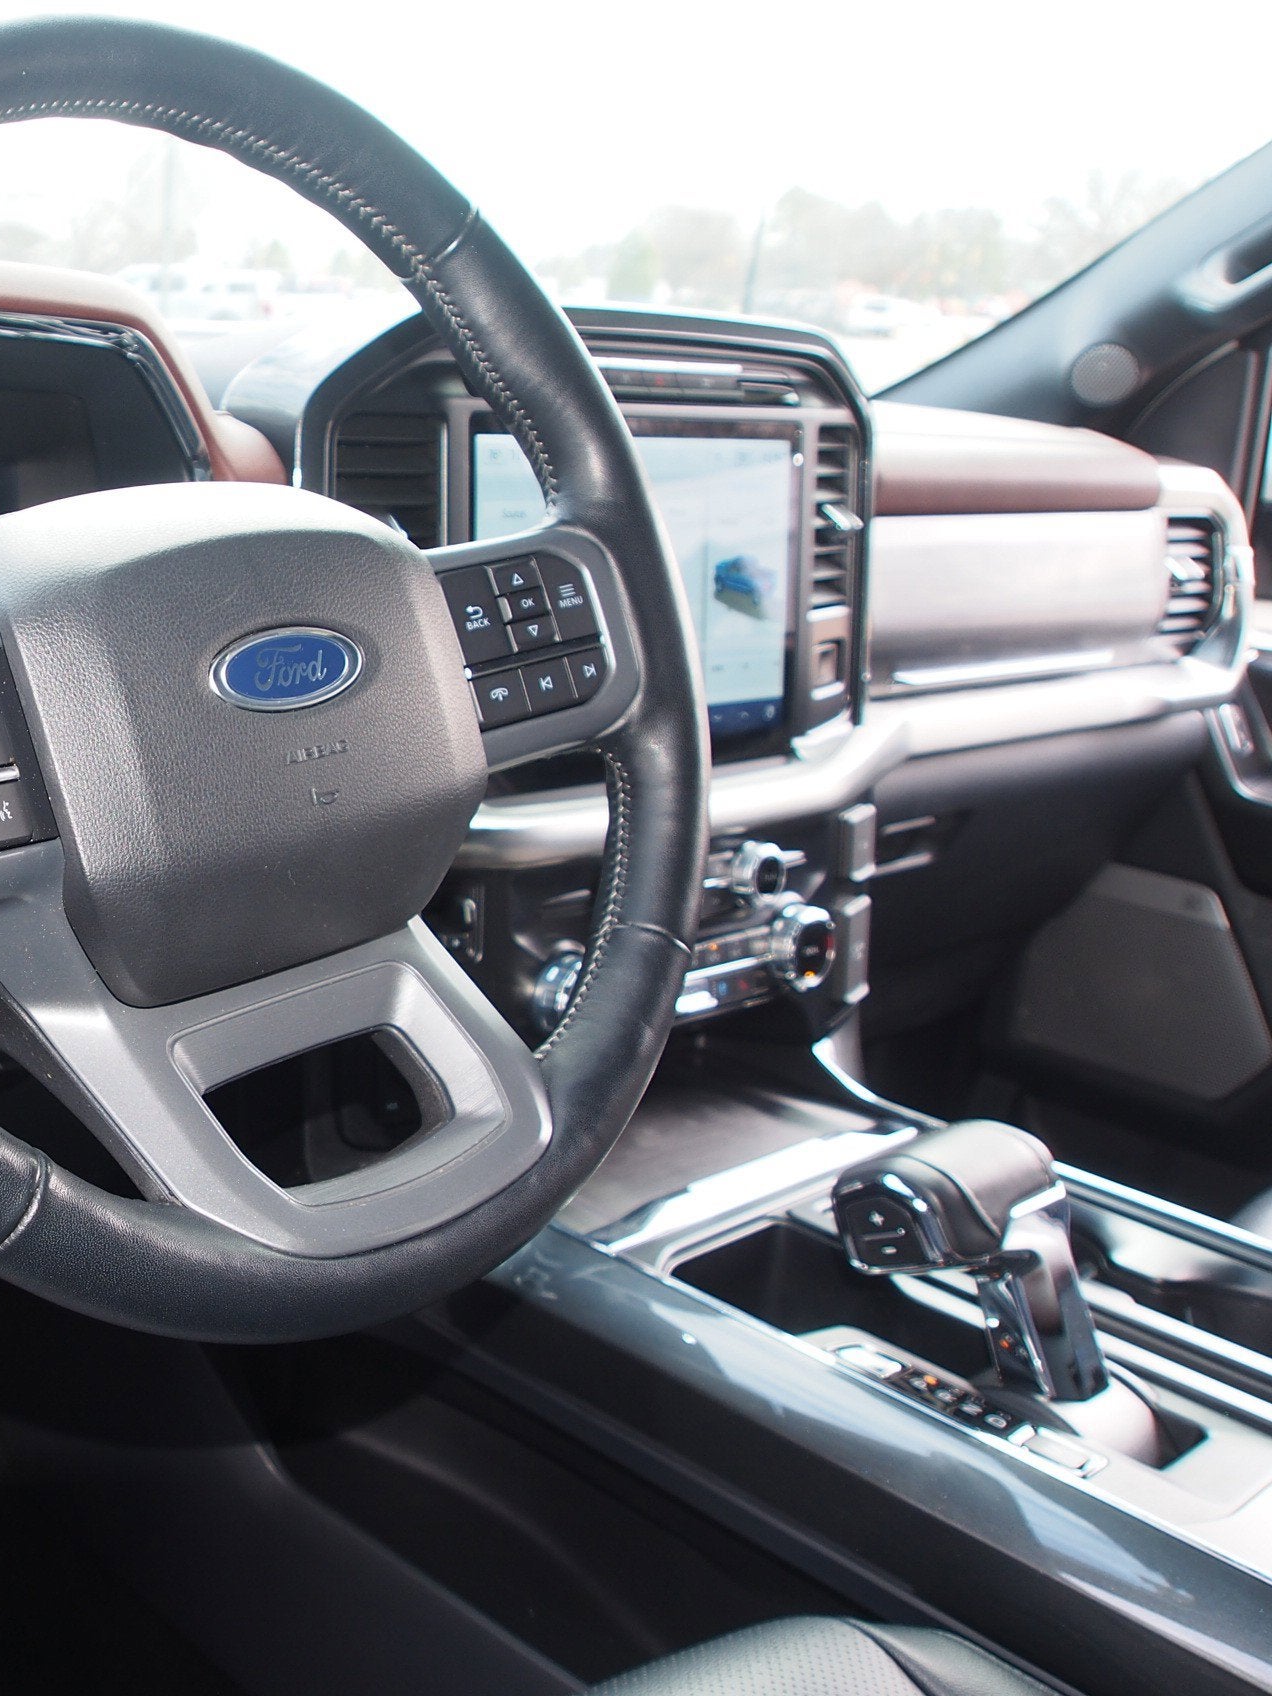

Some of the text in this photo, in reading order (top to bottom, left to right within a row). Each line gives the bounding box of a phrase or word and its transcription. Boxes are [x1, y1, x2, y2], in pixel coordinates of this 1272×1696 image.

[521, 598, 535, 608] OK
[559, 596, 584, 608] MENU
[465, 619, 491, 631] BACK
[254, 643, 328, 691] Ford
